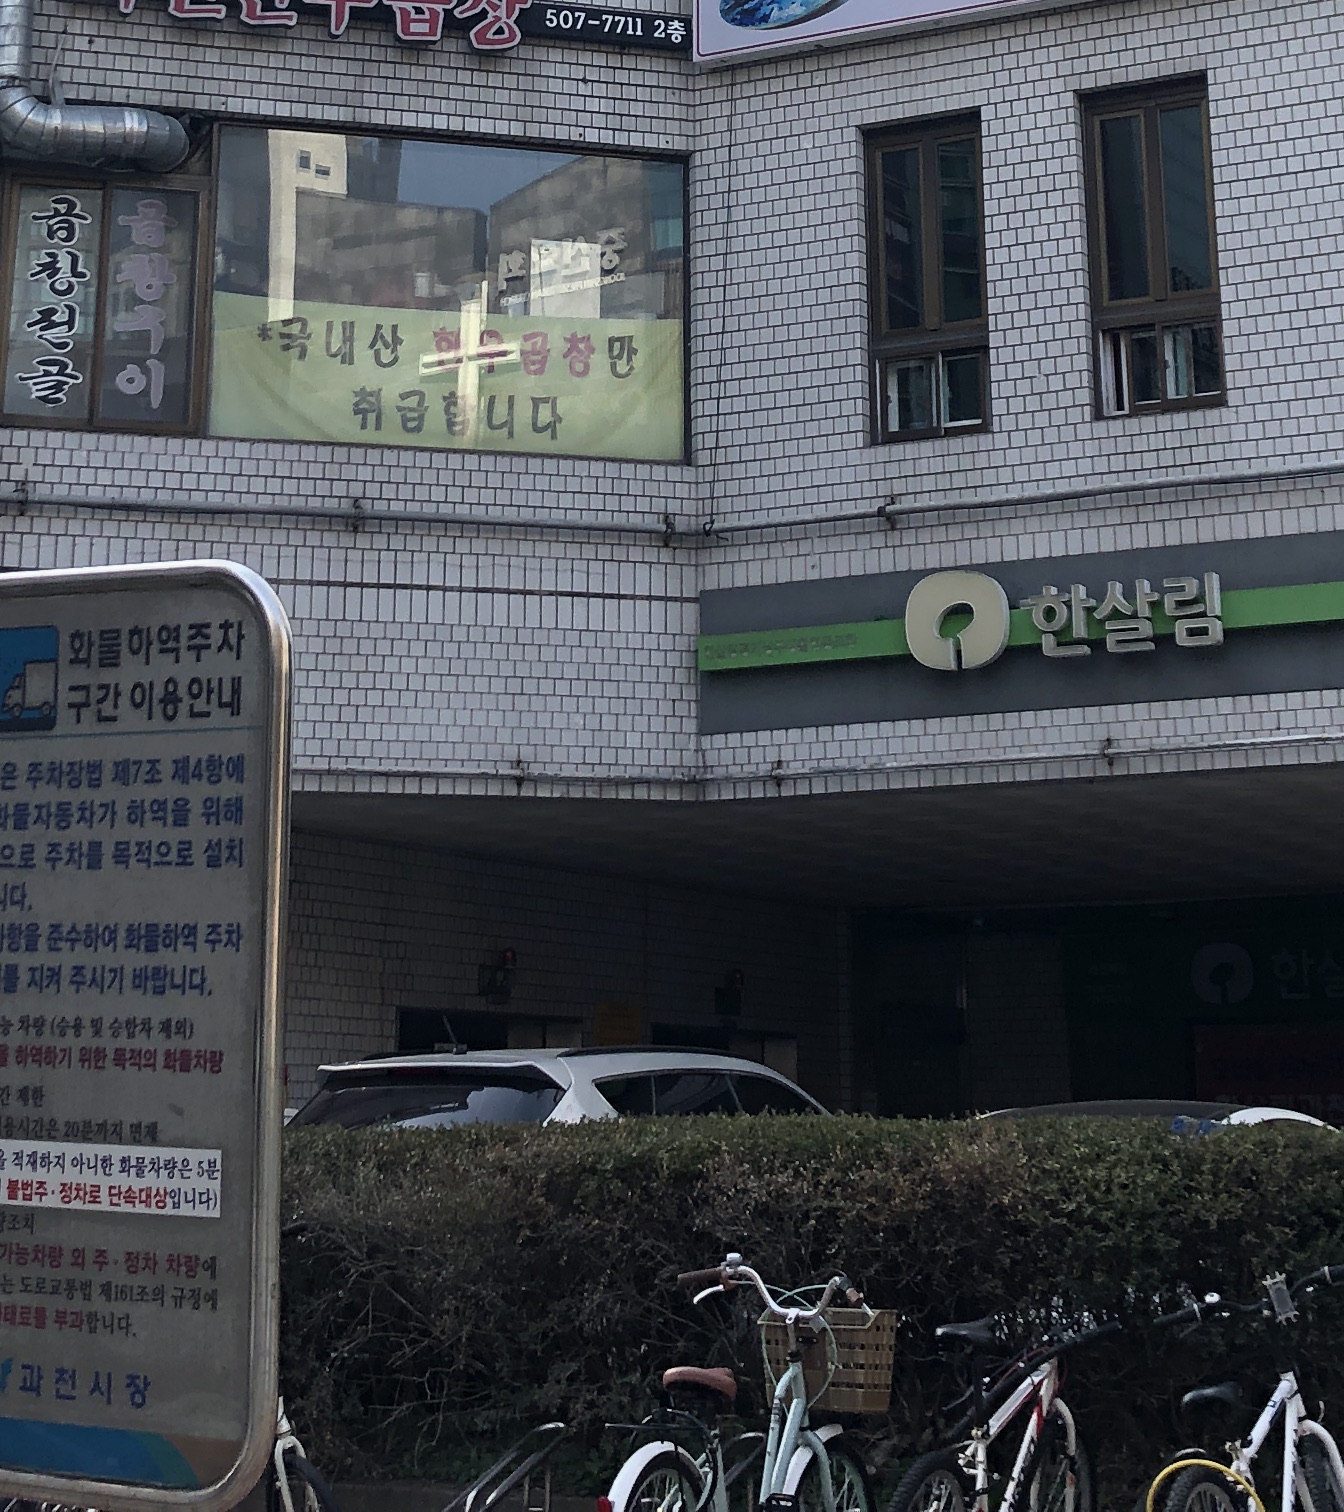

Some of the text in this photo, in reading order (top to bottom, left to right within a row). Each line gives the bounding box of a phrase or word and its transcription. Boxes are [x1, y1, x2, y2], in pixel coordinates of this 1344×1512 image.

[544, 7, 688, 45] 507-7711 2층
[1020, 571, 1224, 659] 한살림
[67, 619, 247, 670] 화물하역주차
[25, 758, 104, 791] 주차장법
[111, 756, 163, 787] 제7조
[170, 753, 246, 785] 제4항에
[126, 795, 192, 829] 하역을
[200, 793, 245, 828] 위해
[43, 839, 105, 871] 주차를
[111, 838, 196, 870] 목적으로
[203, 836, 245, 869] 설치
[45, 921, 120, 954] 준수하여
[203, 921, 244, 954] 주차
[25, 963, 63, 996] 지켜
[68, 963, 126, 996] 주시기
[14, 1043, 73, 1070] 하역하기
[77, 1044, 108, 1071] 위한
[112, 1046, 158, 1073] 목적의
[162, 1047, 225, 1075] 화물차량
[11, 1148, 67, 1175] 적재하지
[70, 1152, 115, 1177] 아니한
[118, 1155, 194, 1180] 화물차량은
[196, 1157, 221, 1181] 5분
[69, 1247, 87, 1270] 외
